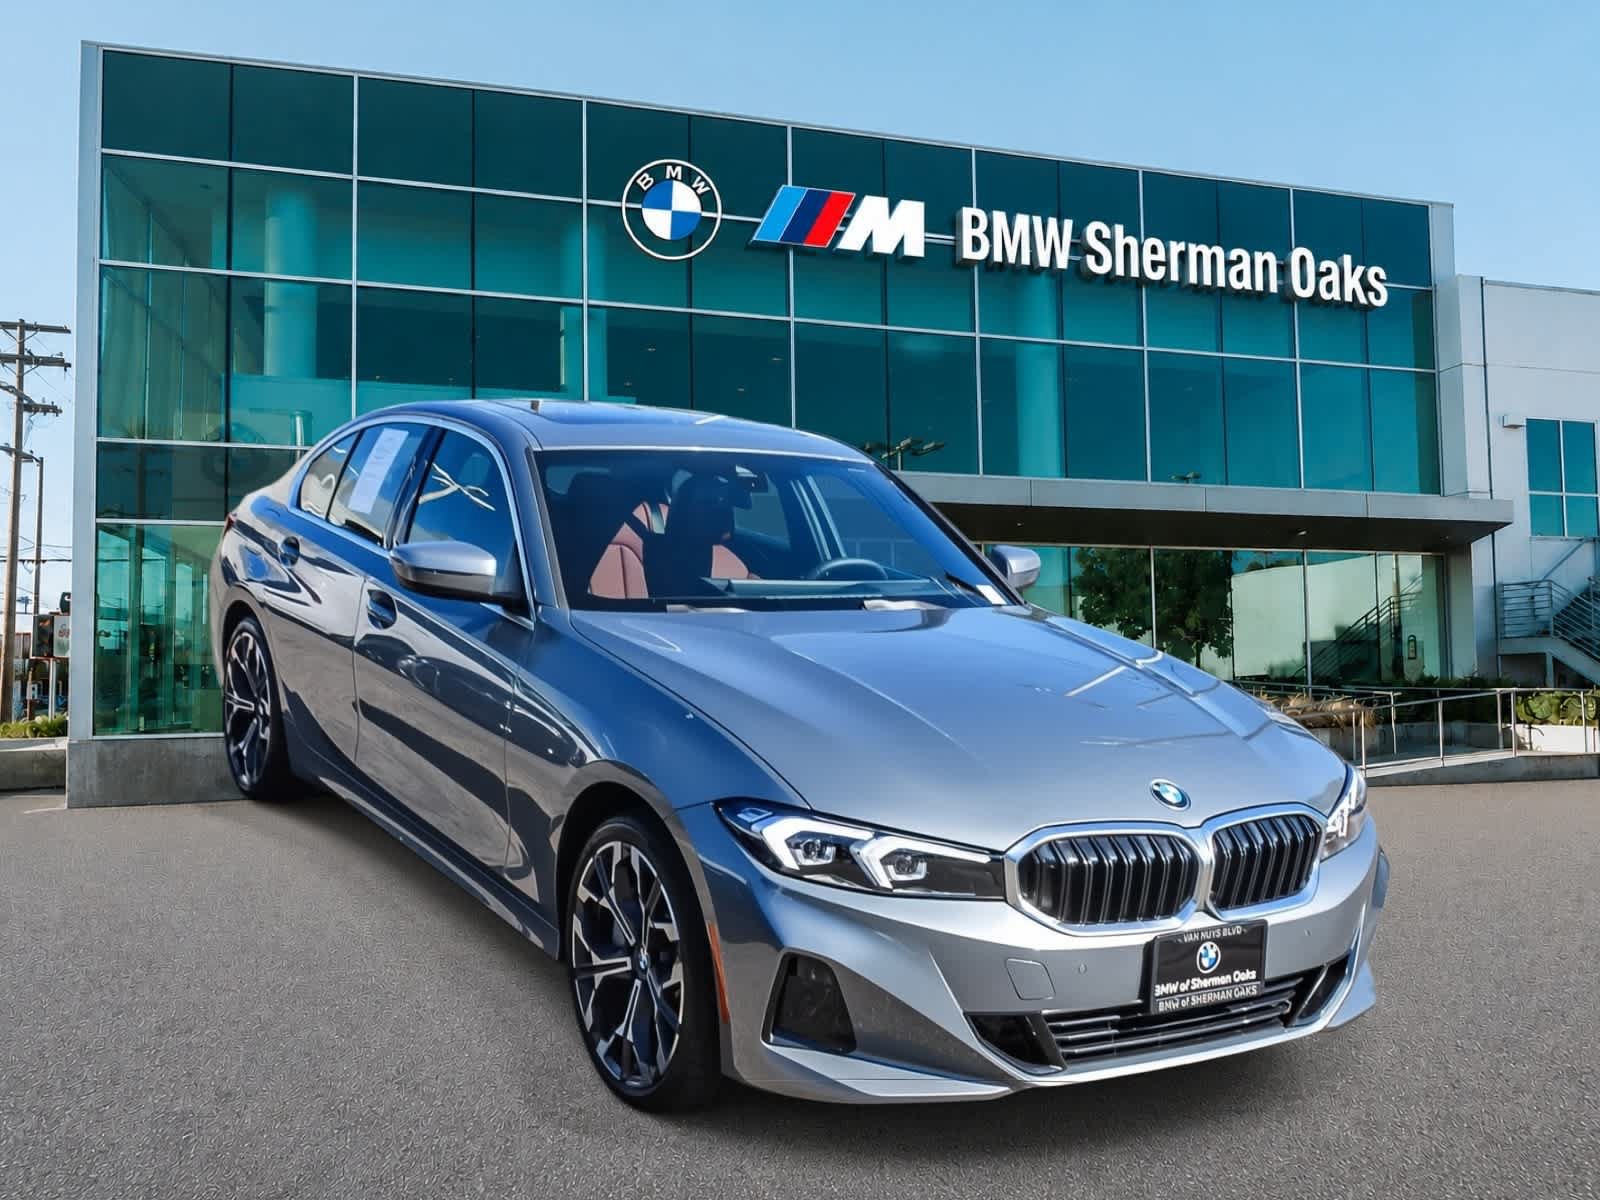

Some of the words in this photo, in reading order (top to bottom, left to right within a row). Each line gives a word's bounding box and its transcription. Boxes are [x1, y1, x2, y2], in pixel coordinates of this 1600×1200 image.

[636, 165, 711, 196] BMW
[961, 206, 1074, 269] BMW
[1085, 221, 1278, 293] Sherman
[1289, 246, 1388, 308] Oaks
[1183, 931, 1200, 943] VAN
[1200, 929, 1221, 940] NUYS
[1222, 926, 1242, 937] BLVD
[1179, 980, 1190, 992] of
[1191, 974, 1231, 990] Sherman
[1233, 968, 1257, 983] Oaks
[1158, 998, 1179, 1012] BMW
[1181, 997, 1189, 1007] of
[1191, 990, 1232, 1006] SHERMAN
[1233, 985, 1257, 999] OAKS
